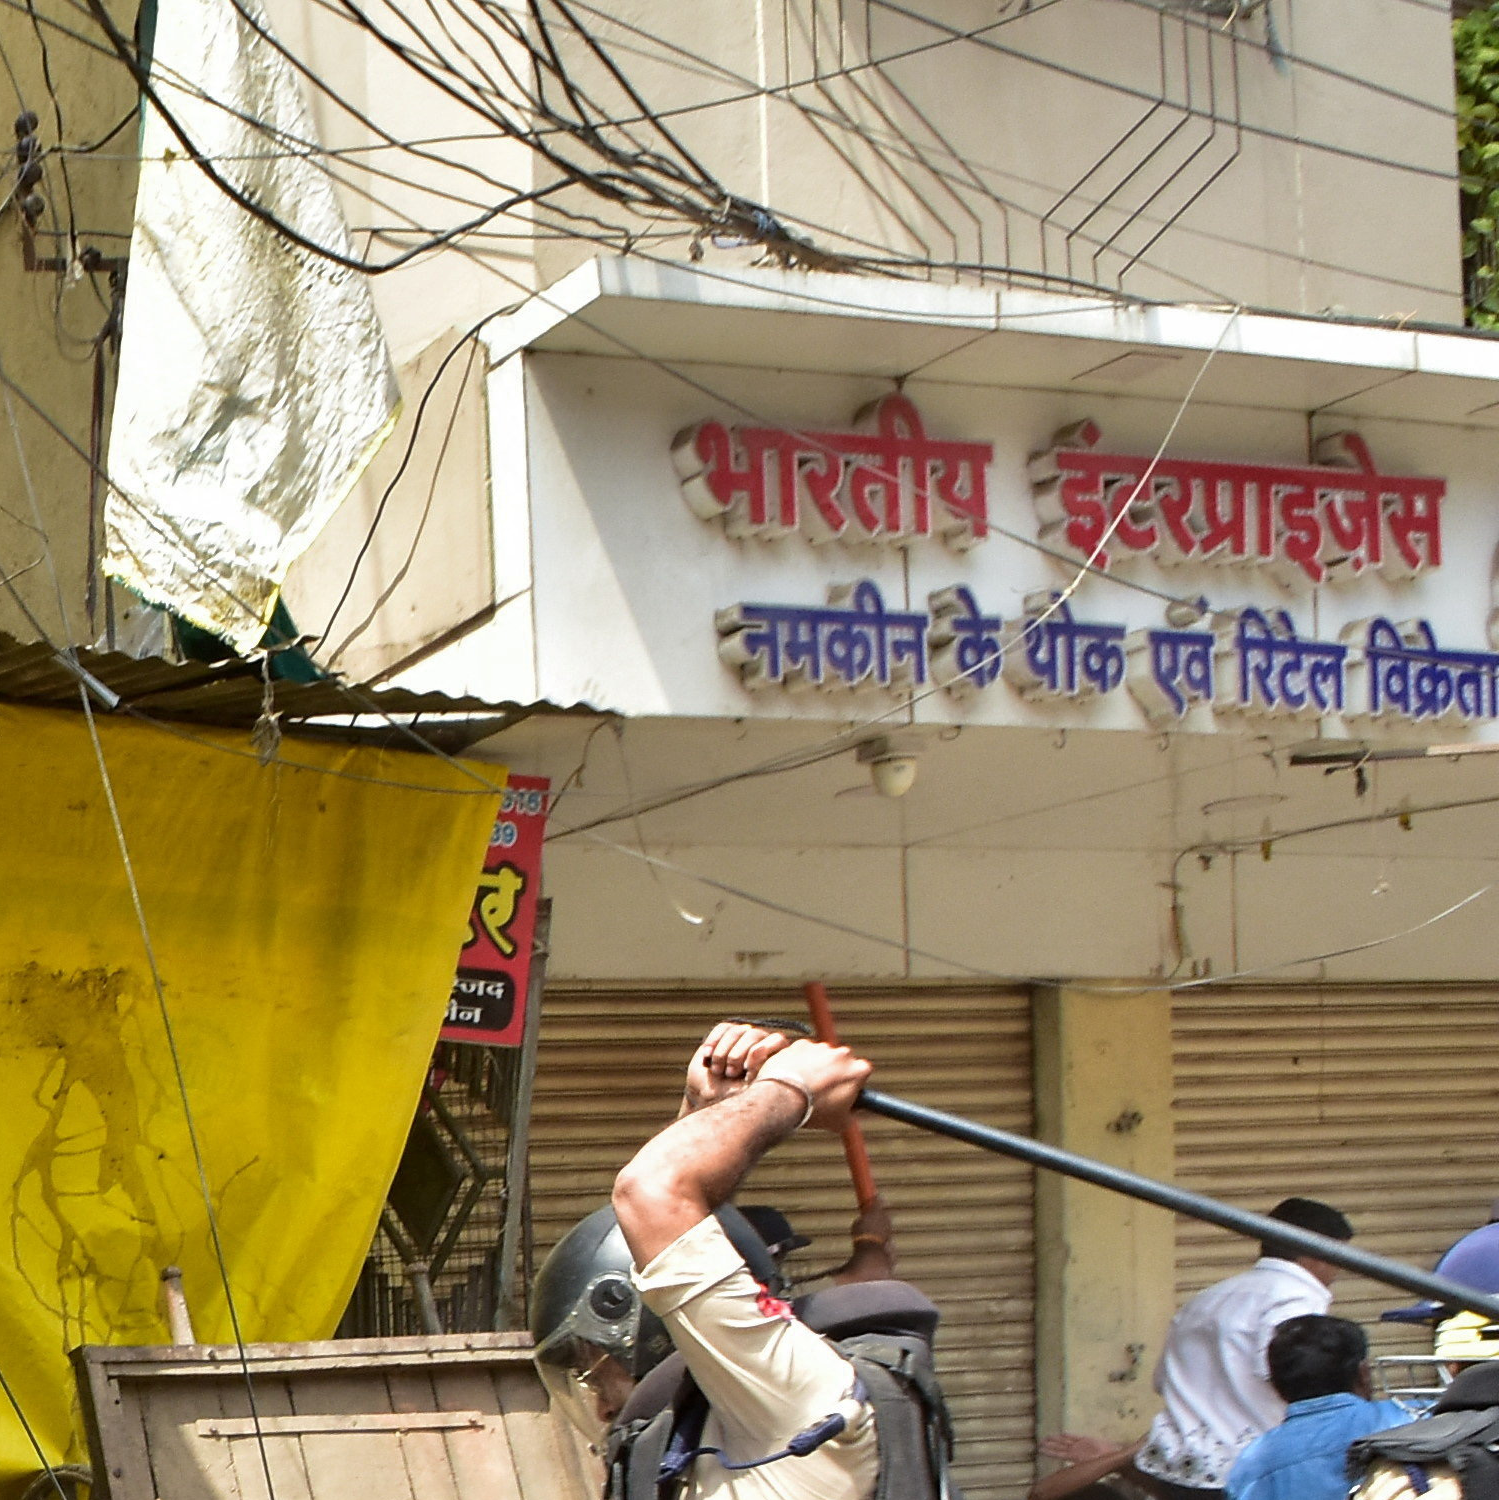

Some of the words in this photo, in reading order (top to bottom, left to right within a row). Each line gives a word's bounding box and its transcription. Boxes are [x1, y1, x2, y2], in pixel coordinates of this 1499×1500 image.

[691, 392, 994, 545] भारतीय
[739, 580, 930, 686] नमकीन
[951, 585, 1001, 689] के
[1023, 592, 1128, 695] थोक
[1233, 606, 1348, 713] रिटेल
[1366, 617, 1499, 718] विक्रेता
